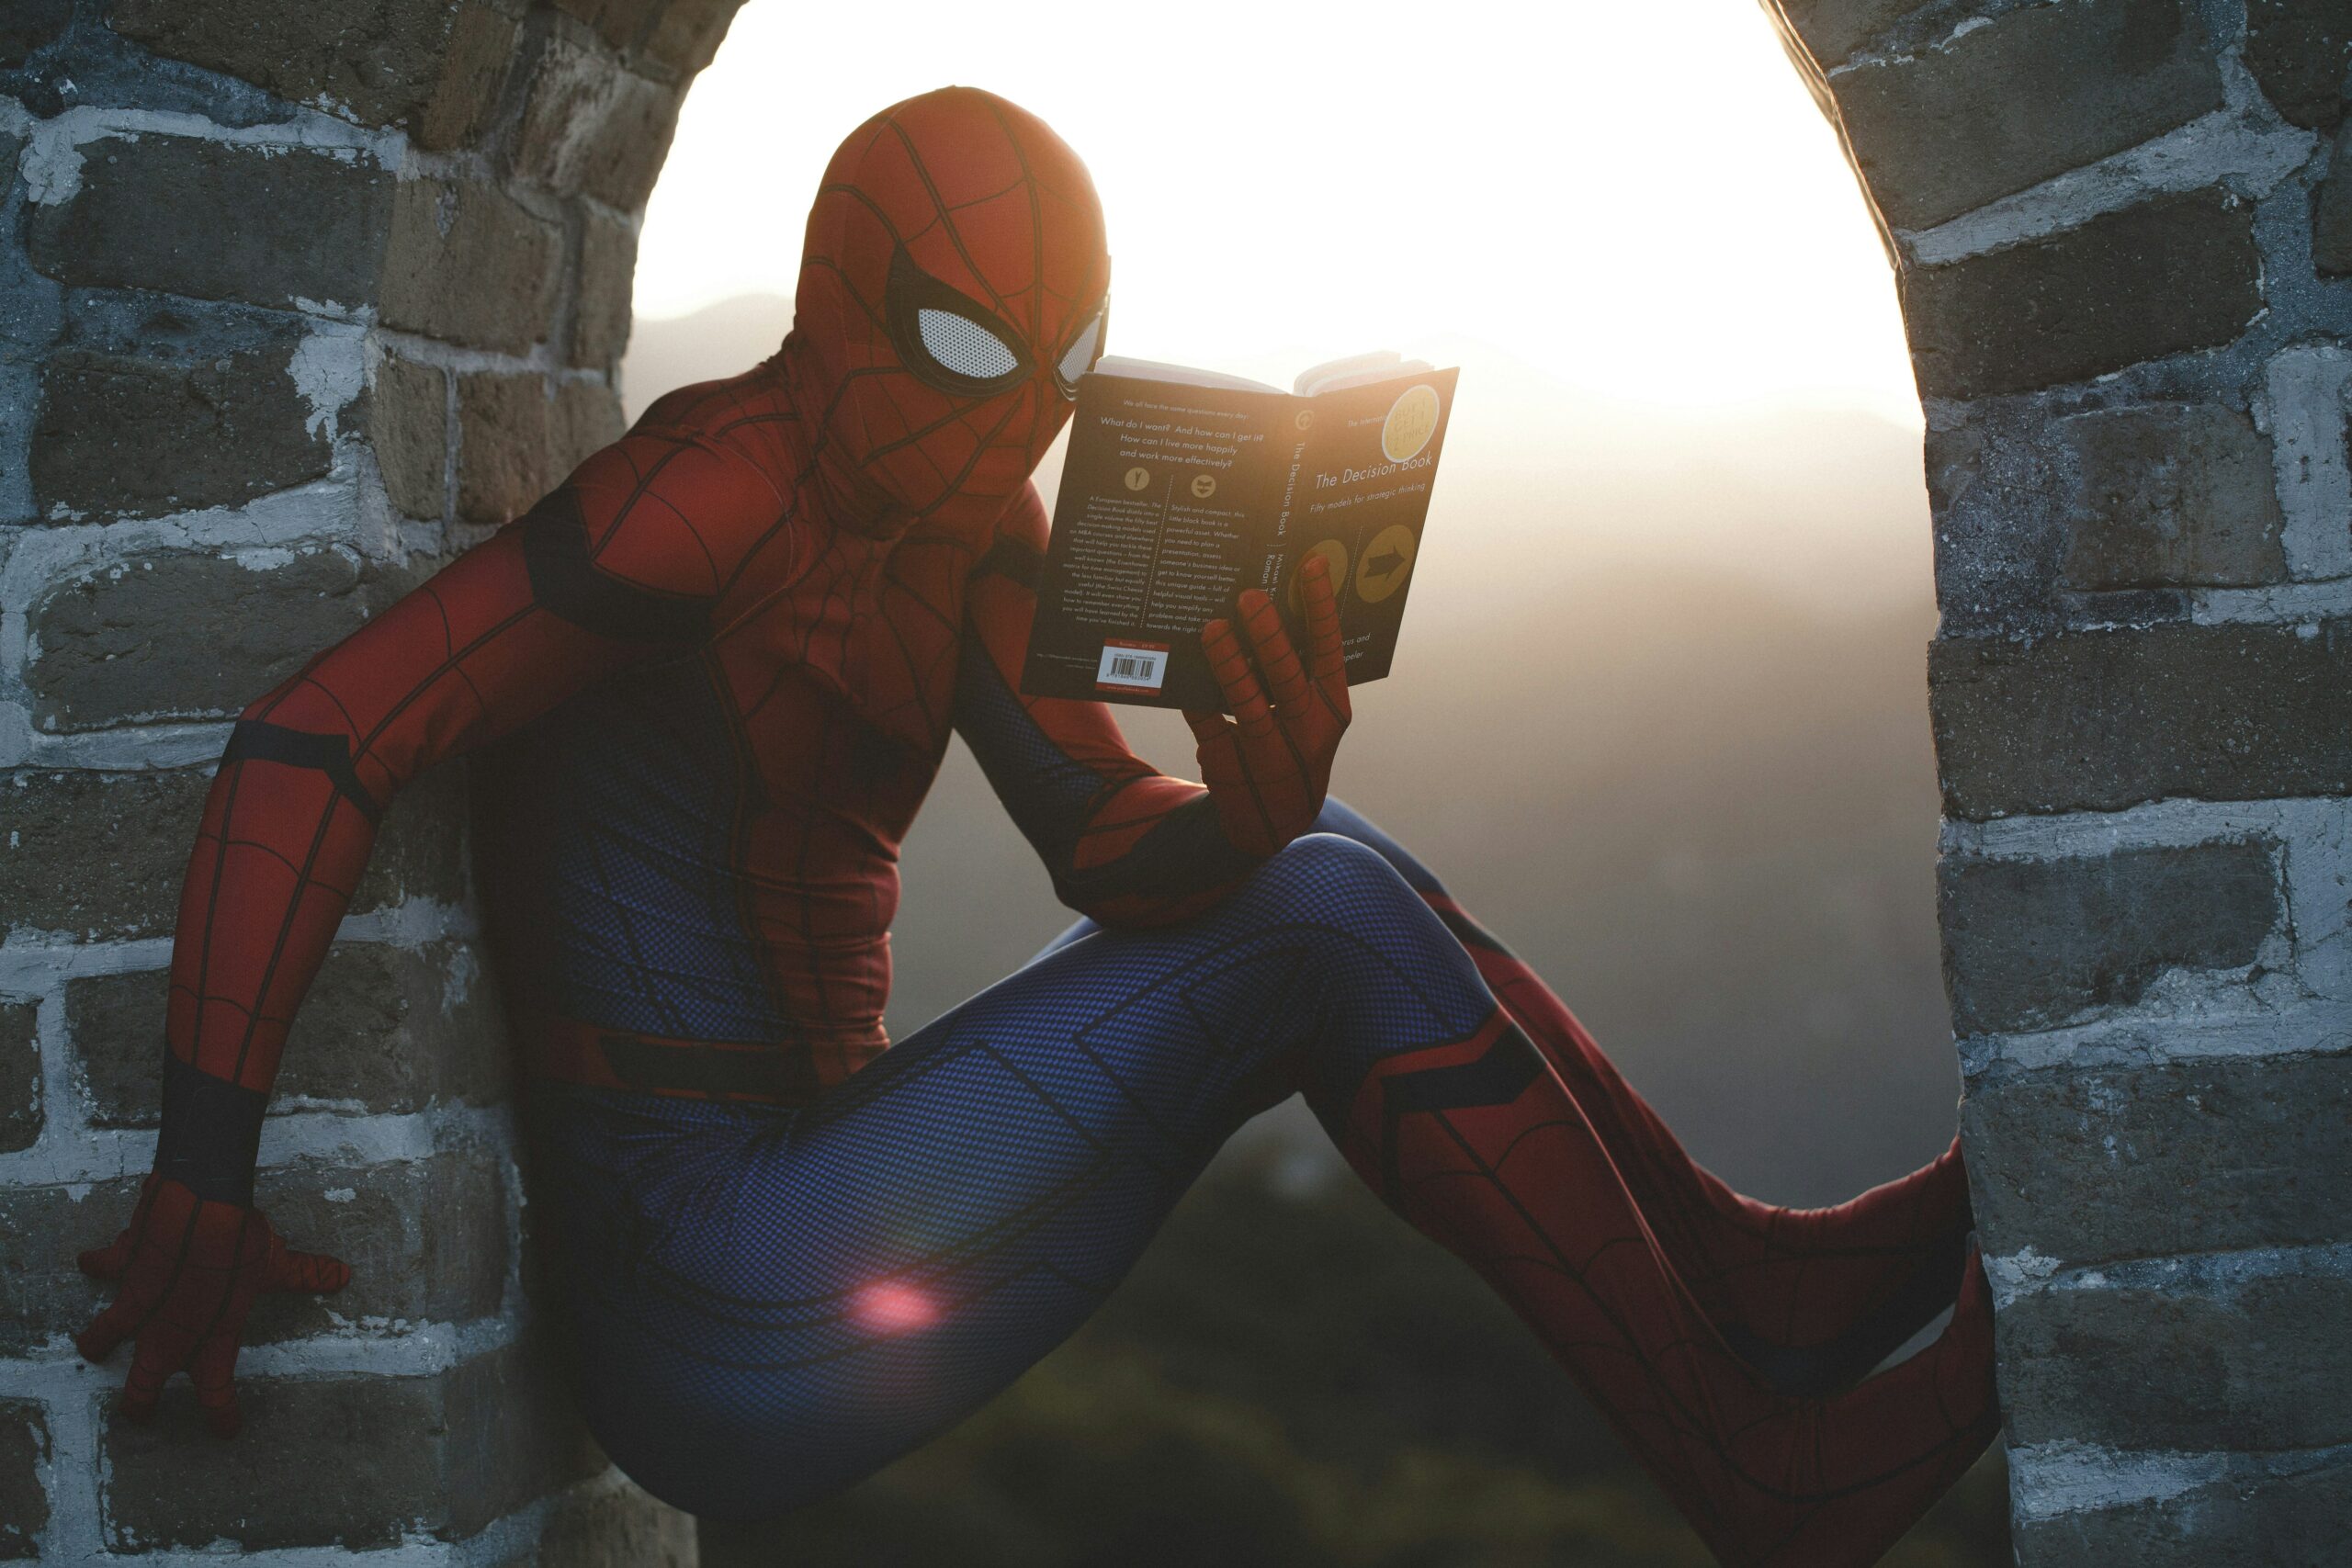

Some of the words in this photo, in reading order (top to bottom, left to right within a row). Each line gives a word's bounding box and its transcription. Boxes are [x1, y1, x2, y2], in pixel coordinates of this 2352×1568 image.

[1101, 417, 1125, 427] What
[1125, 420, 1137, 429] do
[1139, 421, 1143, 429] I
[1145, 423, 1171, 432] want?
[1175, 425, 1193, 434] And
[1194, 427, 1213, 436] how
[1232, 431, 1237, 439] I
[1237, 433, 1251, 443] get
[1253, 434, 1264, 442] it?
[1120, 434, 1140, 443] How
[1165, 438, 1181, 447] live
[1206, 443, 1238, 456] happily
[1294, 441, 1306, 459] The
[1119, 449, 1137, 457] and
[1138, 452, 1160, 460] work
[1185, 456, 1233, 469] effectively?
[1316, 474, 1338, 489] The
[1342, 462, 1396, 483] Decision
[1401, 451, 1432, 471] Book
[1283, 464, 1301, 507] Decision
[1171, 504, 1191, 513] Stylish
[1310, 503, 1325, 513] Fifty
[1328, 499, 1352, 509] models
[1354, 495, 1364, 503] for
[1366, 489, 1396, 502] strategic
[1398, 483, 1426, 494] thinking
[1277, 511, 1290, 536] Book
[1213, 531, 1239, 539] Whether
[1262, 554, 1275, 584] Roman
[1272, 553, 1284, 584] Mikael
[1153, 591, 1173, 599] helpful
[1151, 601, 1164, 609] help
[1178, 604, 1201, 613] simplify
[1356, 632, 1371, 643] and
